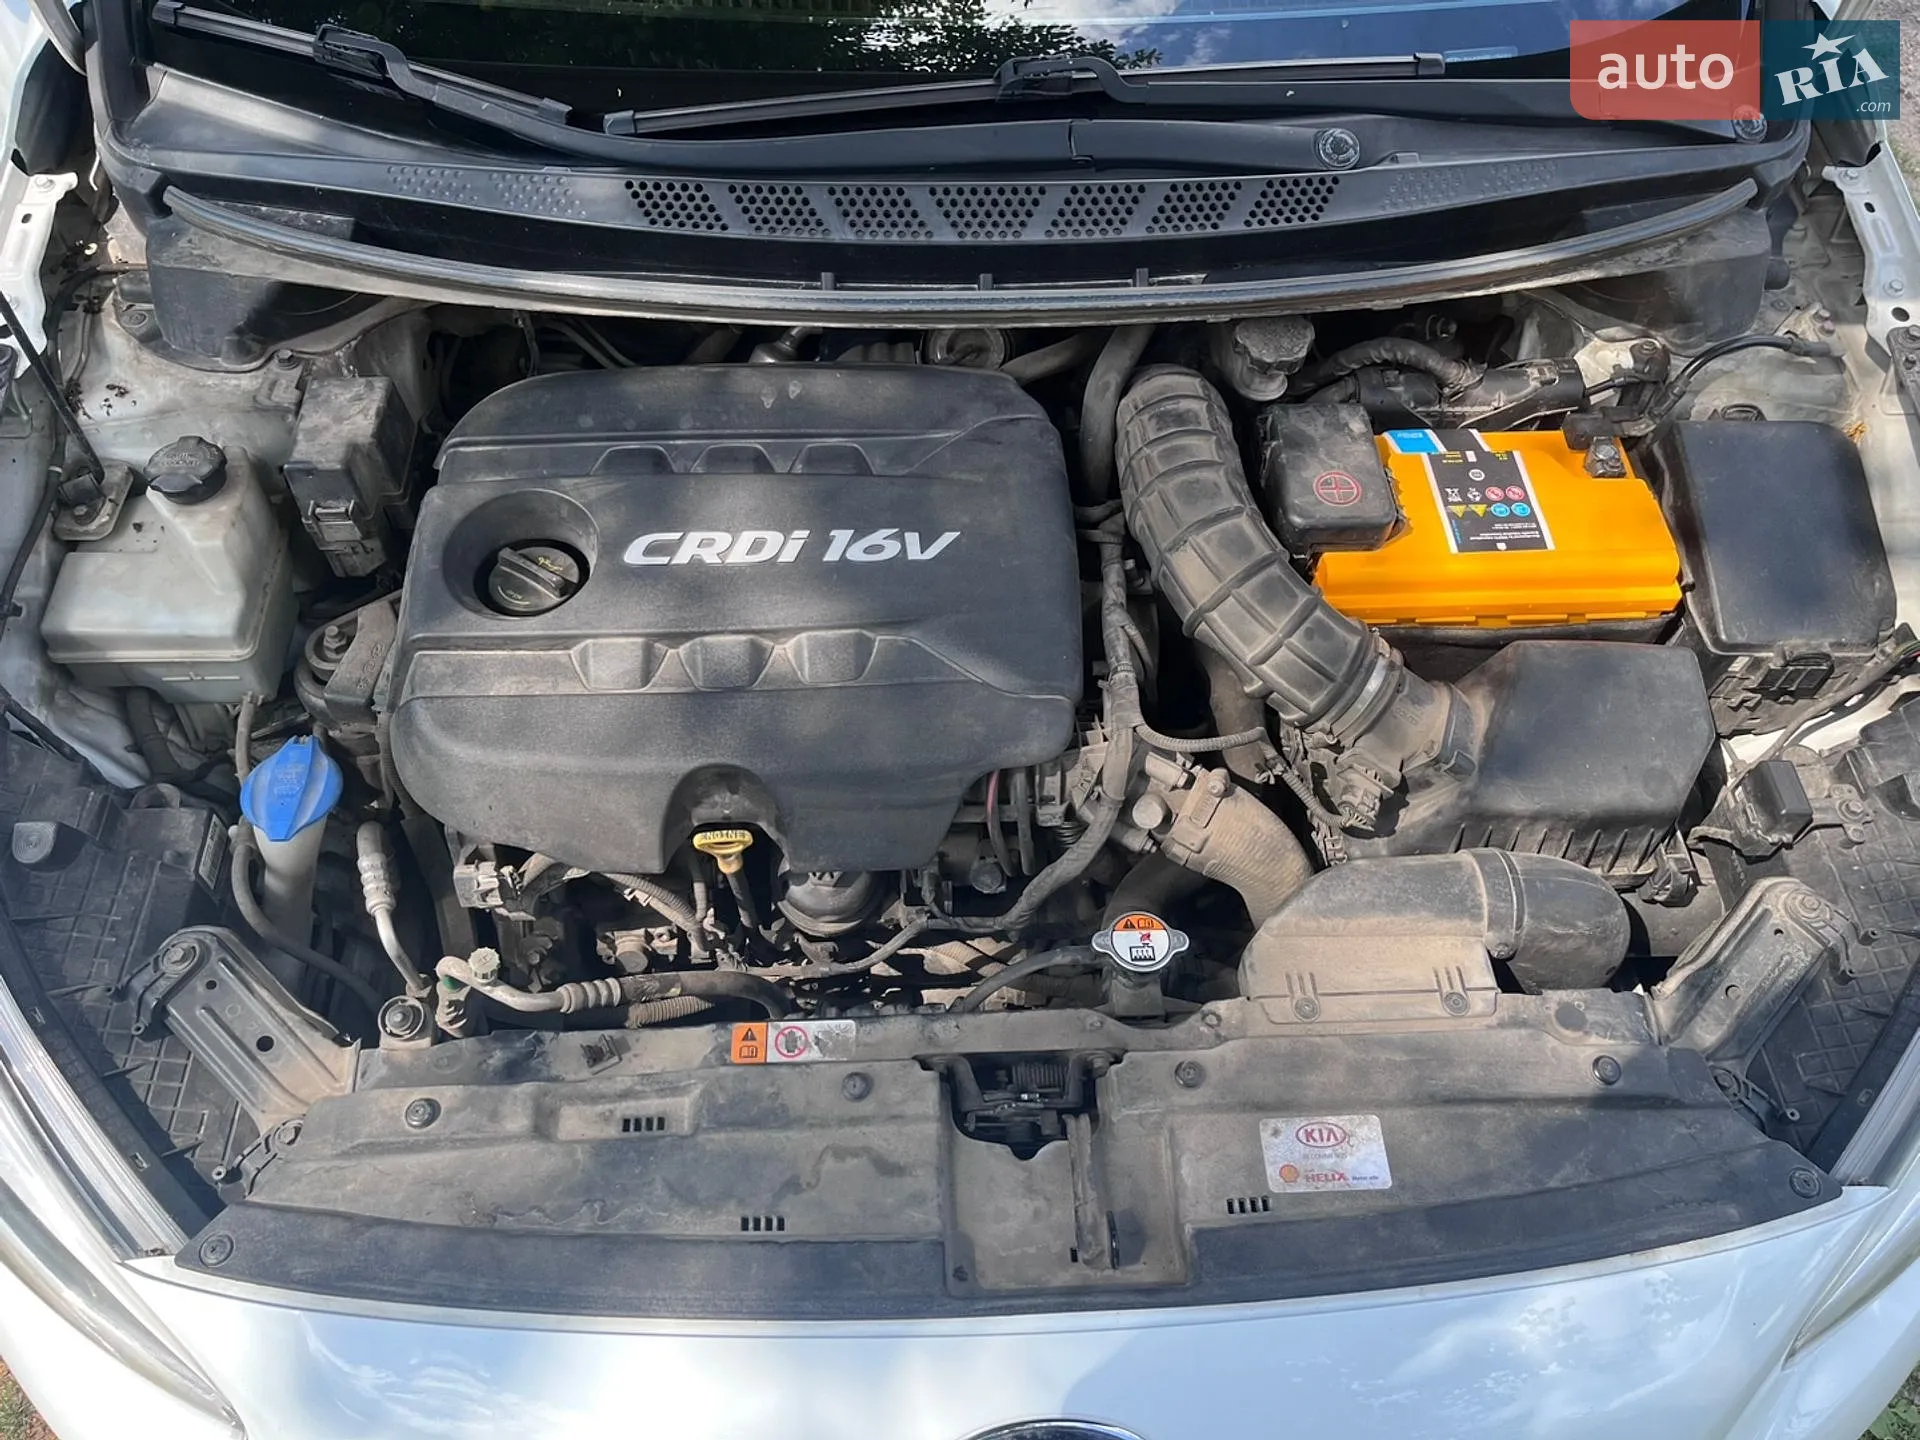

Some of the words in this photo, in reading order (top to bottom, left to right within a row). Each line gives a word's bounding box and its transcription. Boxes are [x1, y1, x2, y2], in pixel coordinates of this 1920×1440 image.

[623, 529, 811, 566] CRDi
[822, 528, 961, 562] 16V
[700, 829, 747, 840] ENGINE
[1304, 1128, 1339, 1143] KIA
[1304, 1173, 1346, 1182] HELIX
